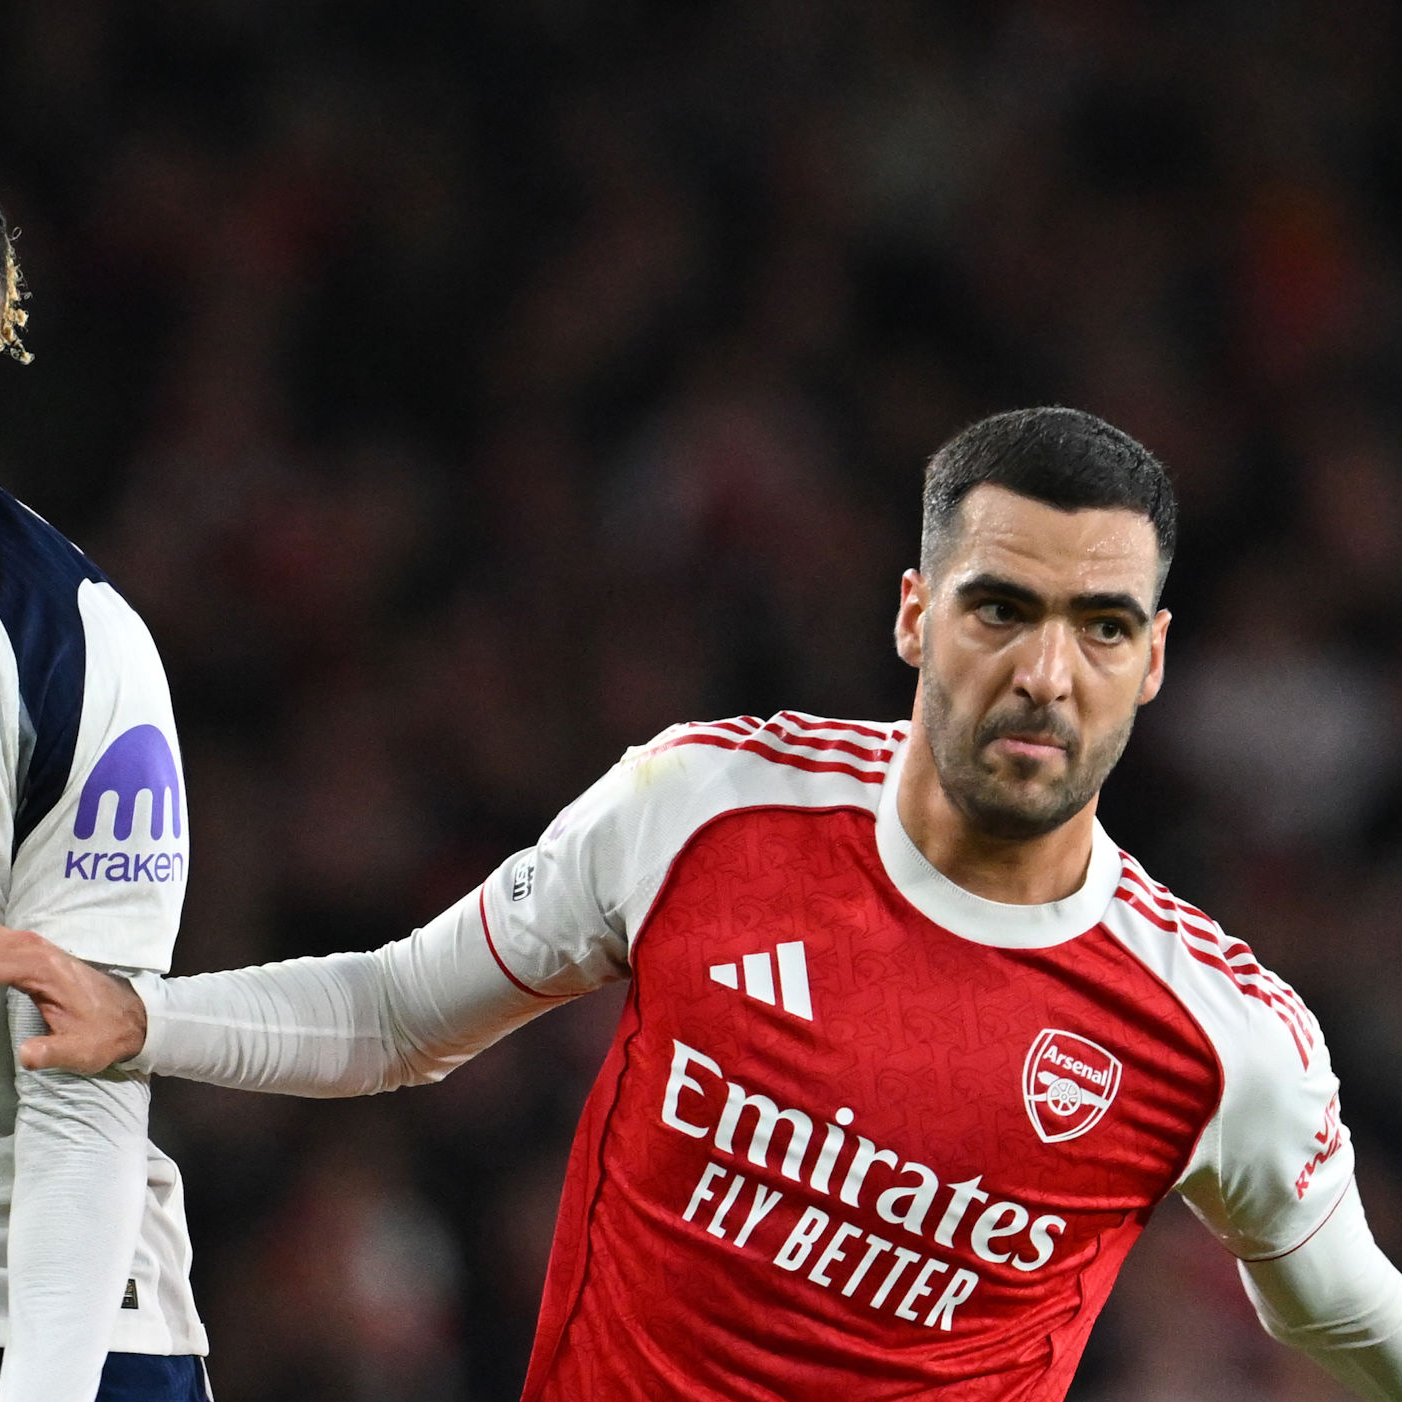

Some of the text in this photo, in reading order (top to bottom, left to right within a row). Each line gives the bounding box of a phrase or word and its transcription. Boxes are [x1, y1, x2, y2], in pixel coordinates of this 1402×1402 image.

[64, 850, 184, 883] kraken
[1042, 1044, 1110, 1087] Arsenal
[661, 1038, 1068, 1273] Emirates
[682, 1162, 980, 1333] FLY BETTER
